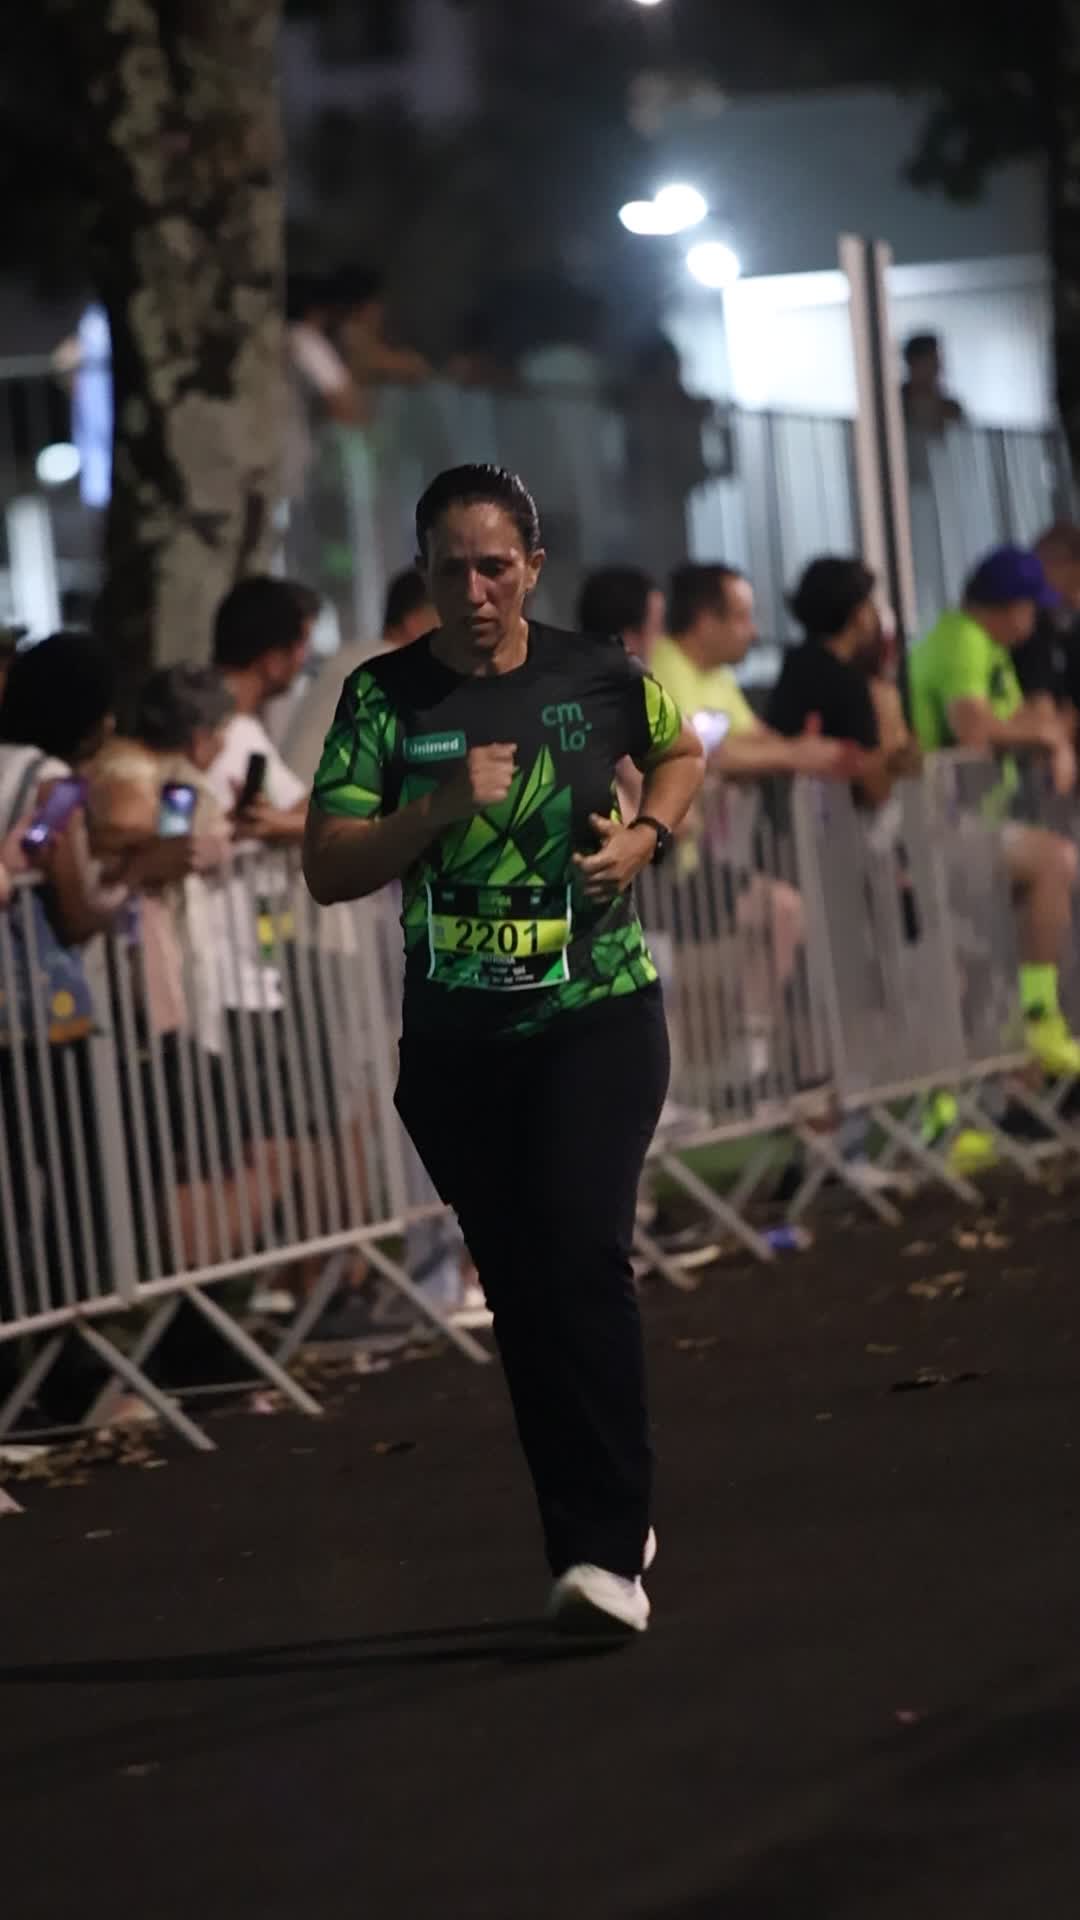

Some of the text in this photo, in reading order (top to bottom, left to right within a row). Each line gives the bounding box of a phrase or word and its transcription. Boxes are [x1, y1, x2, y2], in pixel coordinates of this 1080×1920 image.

[541, 703, 584, 727] cm
[409, 738, 460, 755] Unimed
[455, 920, 538, 954] 2201
